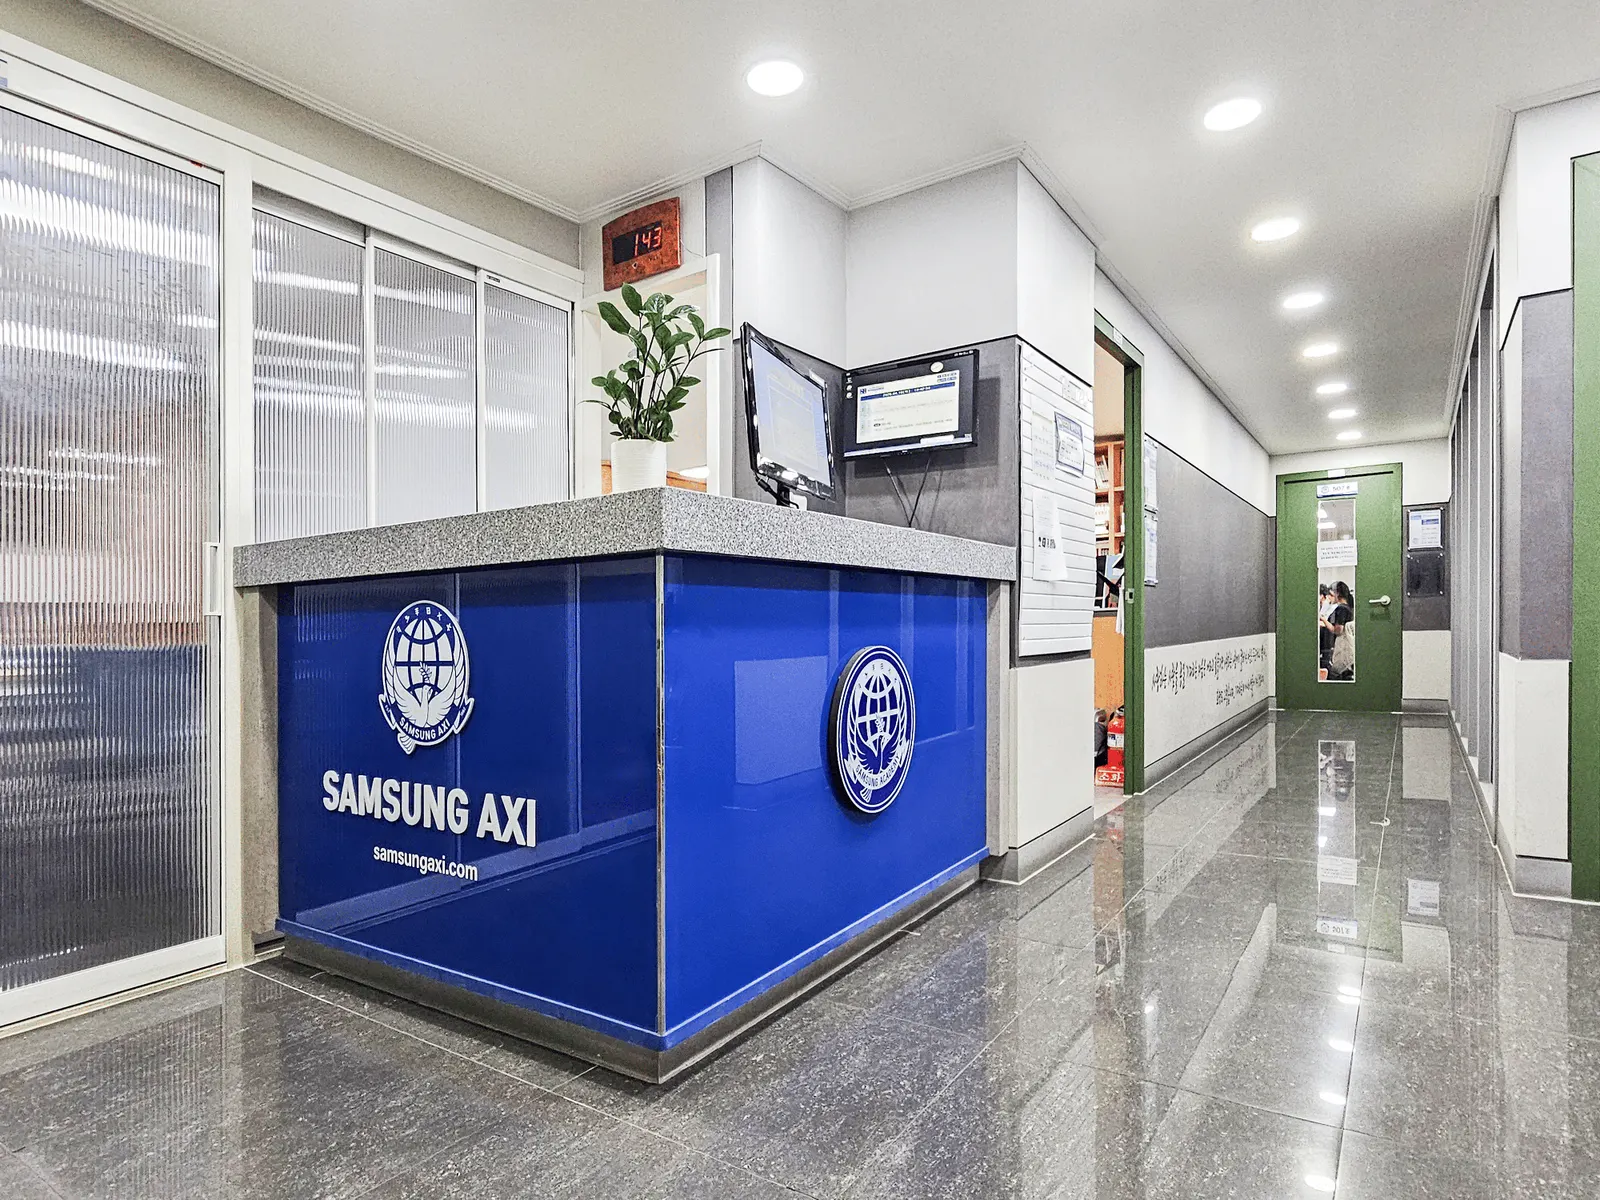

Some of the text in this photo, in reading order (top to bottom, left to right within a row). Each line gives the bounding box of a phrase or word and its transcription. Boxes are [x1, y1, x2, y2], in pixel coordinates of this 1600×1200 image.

[635, 227, 661, 257] 143
[400, 717, 451, 740] SAMSUNG AXI
[855, 764, 878, 787] SAMSUNG
[322, 769, 537, 848] SAMSUNG AXI
[373, 845, 478, 882] samsungaxi.com
